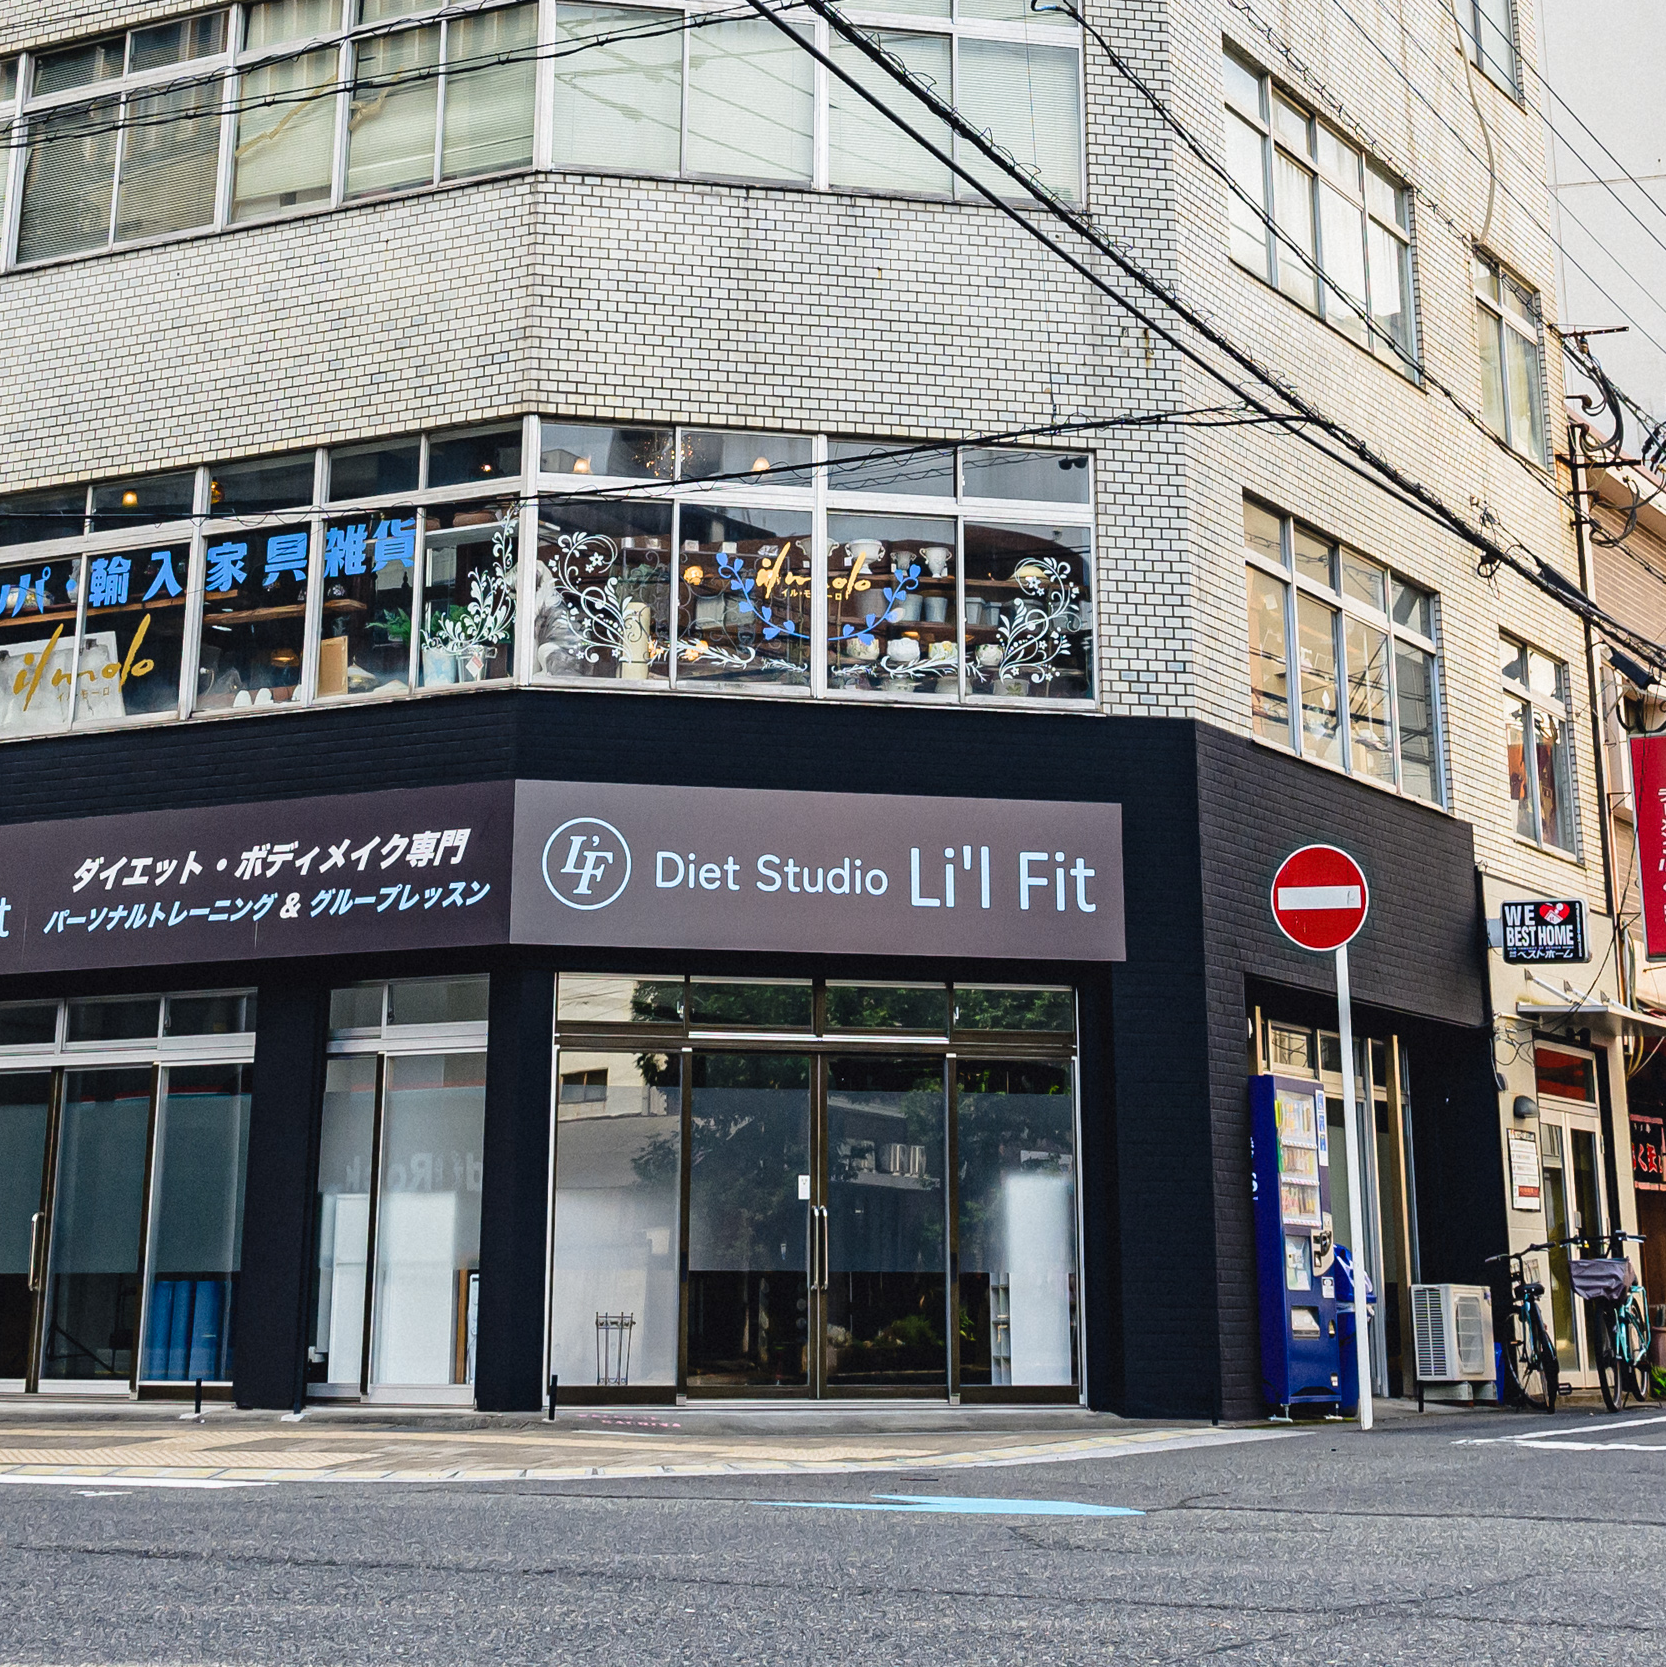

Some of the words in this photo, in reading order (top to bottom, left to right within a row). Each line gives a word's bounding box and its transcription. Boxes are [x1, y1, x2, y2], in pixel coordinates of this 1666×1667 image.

[73, 829, 471, 892] ダイエット・ボディメイク専門
[655, 851, 740, 891] Diet
[756, 855, 889, 896] Studio
[910, 844, 991, 909] Li'l
[1019, 851, 1097, 912] Fit
[43, 892, 279, 934] パーソナルトレーニング
[279, 892, 301, 919] &
[310, 881, 491, 918] グループレッスン
[1504, 905, 1536, 926] WE
[1506, 926, 1536, 946] BEST
[1537, 925, 1574, 946] HOME
[1518, 949, 1573, 959] ベストホーム
